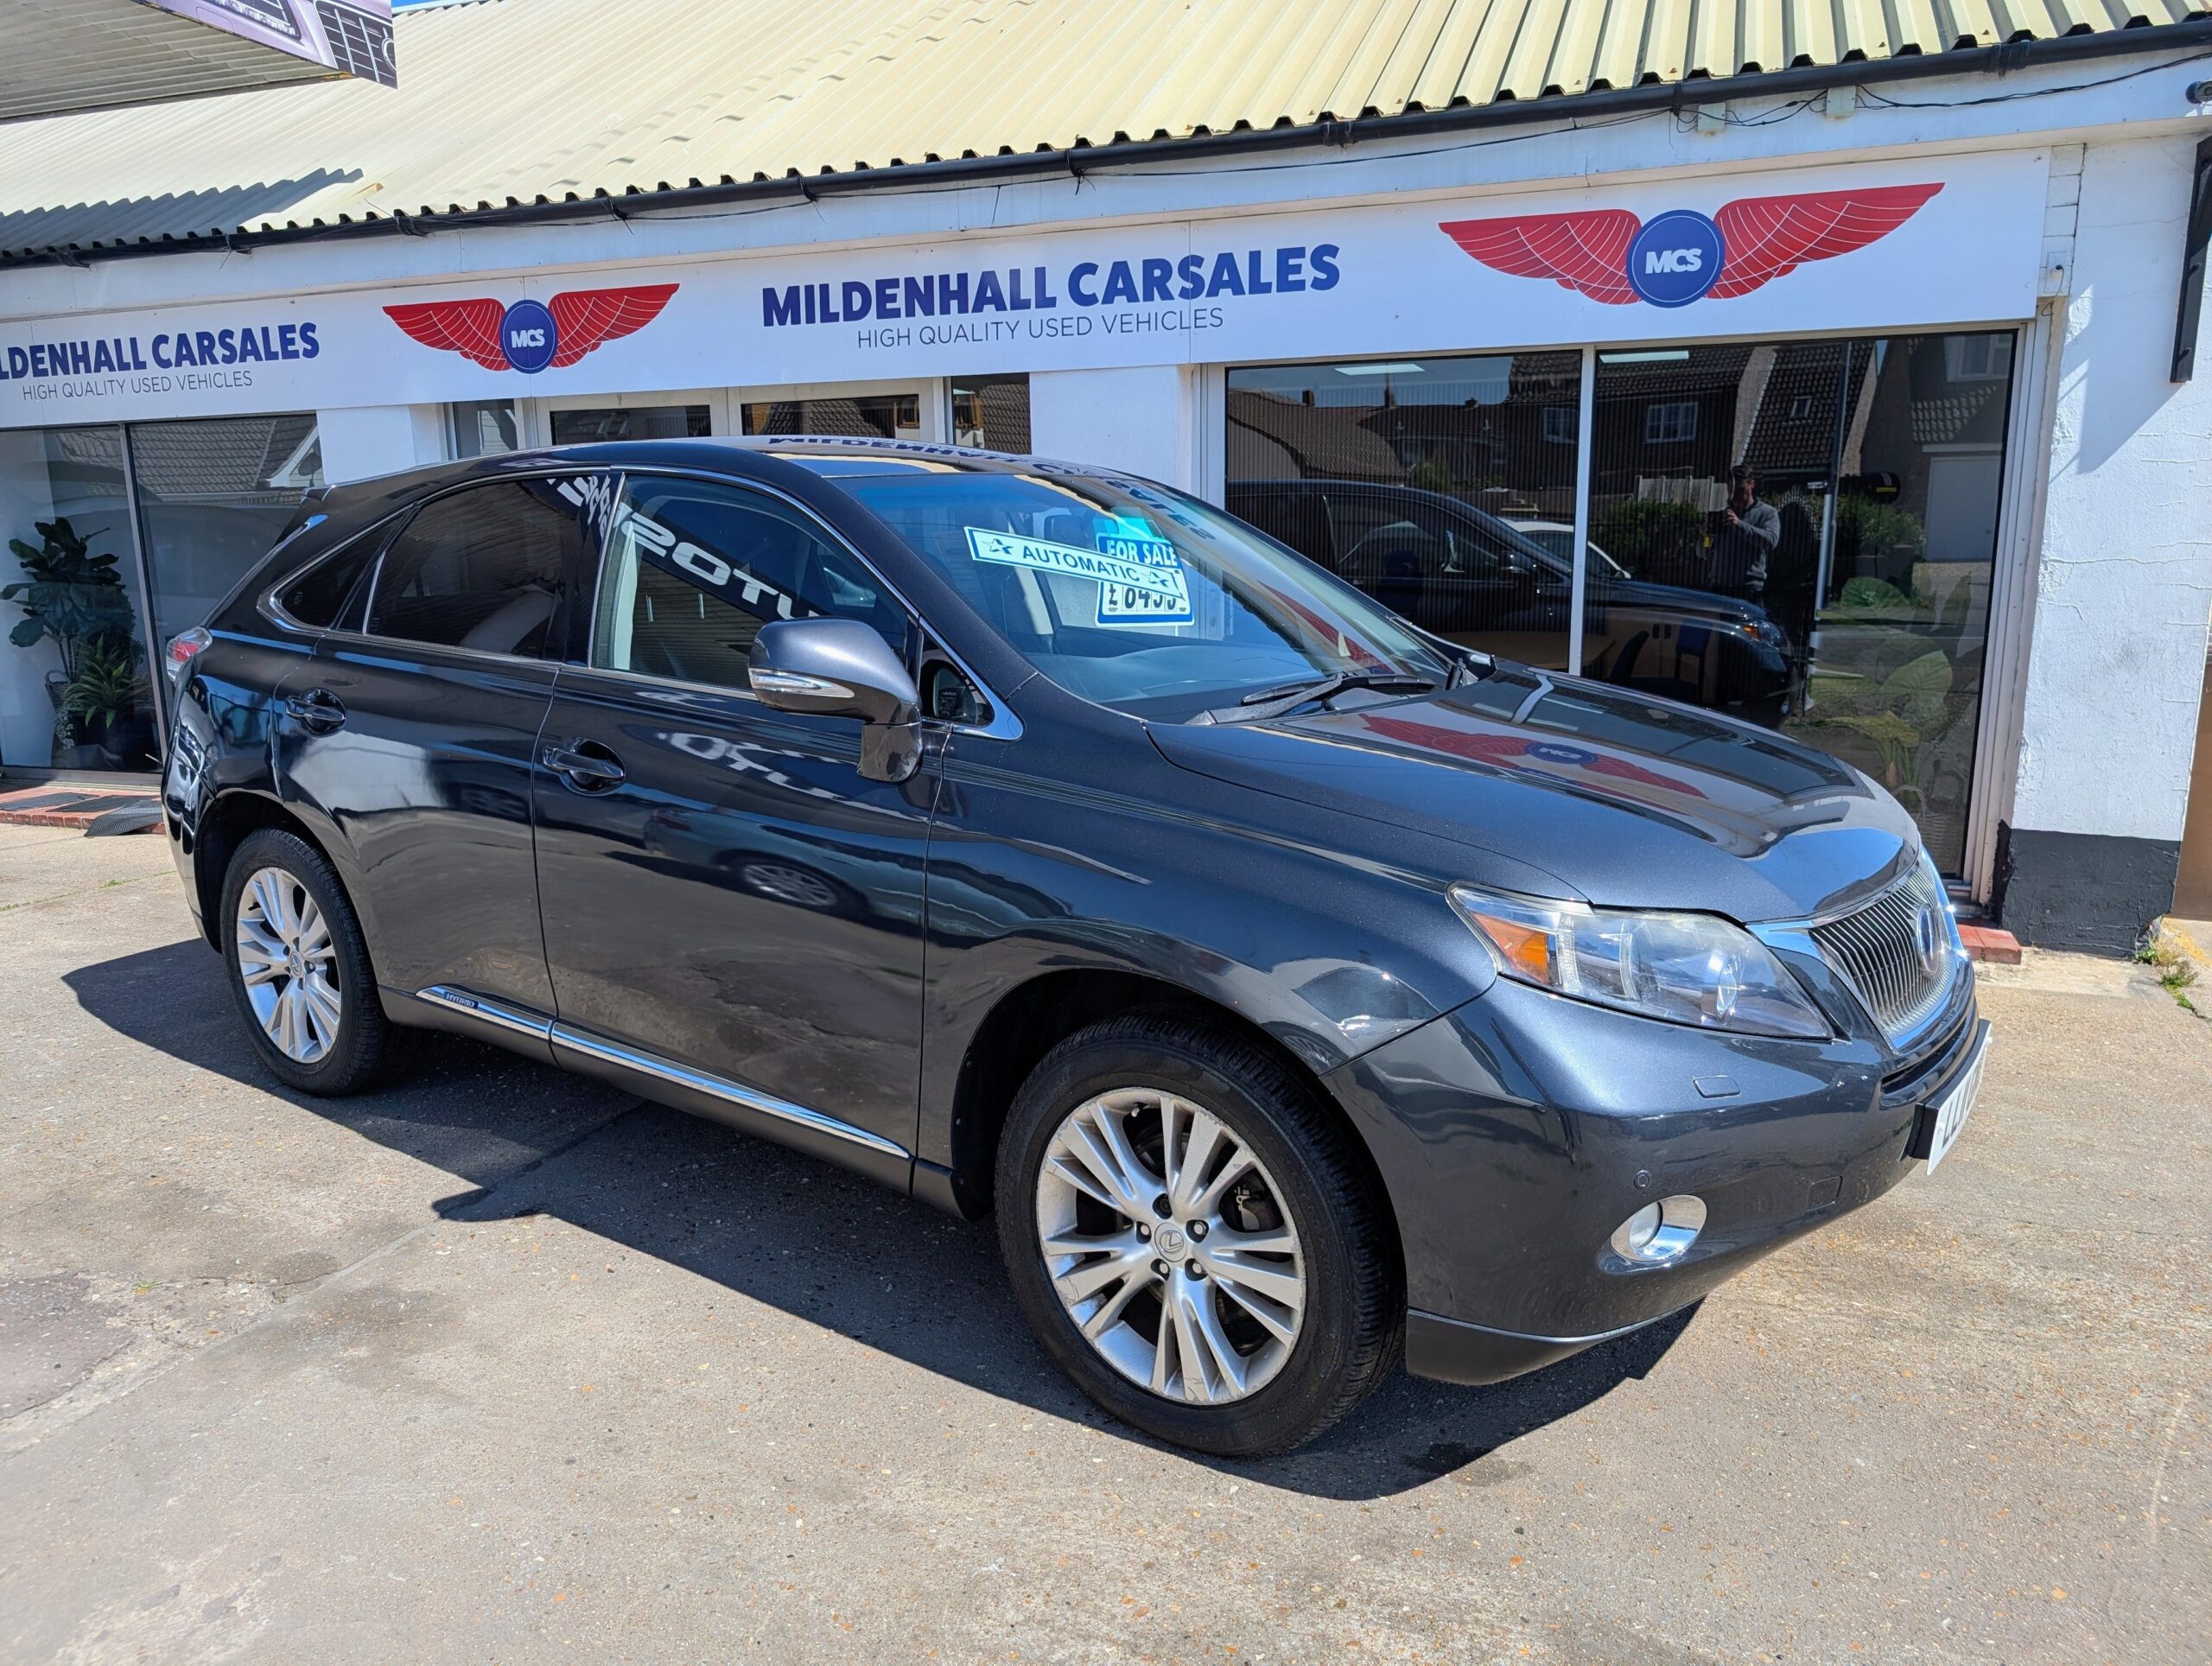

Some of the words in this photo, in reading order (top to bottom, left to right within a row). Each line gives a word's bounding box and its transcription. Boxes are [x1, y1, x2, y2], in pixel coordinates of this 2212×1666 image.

[1645, 248, 1702, 274] MCS
[762, 266, 1058, 327] MILDENHALL
[1067, 244, 1340, 308] CARSALES
[511, 328, 545, 348] MCS
[858, 327, 912, 349] HIGH
[918, 321, 1020, 346] QUALITY
[1028, 315, 1093, 339] USED
[1101, 307, 1224, 334] VEHICLES
[151, 321, 320, 369] CARSALES
[22, 384, 58, 401] HIGH
[61, 378, 126, 398] QUALITY
[130, 376, 172, 394] USED
[175, 370, 253, 391] VEHICLES
[1023, 546, 1141, 582] AUTOMATIC
[1107, 539, 1141, 562] FOR
[1142, 543, 1179, 567] SALE
[446, 993, 475, 1008] HYBRID
